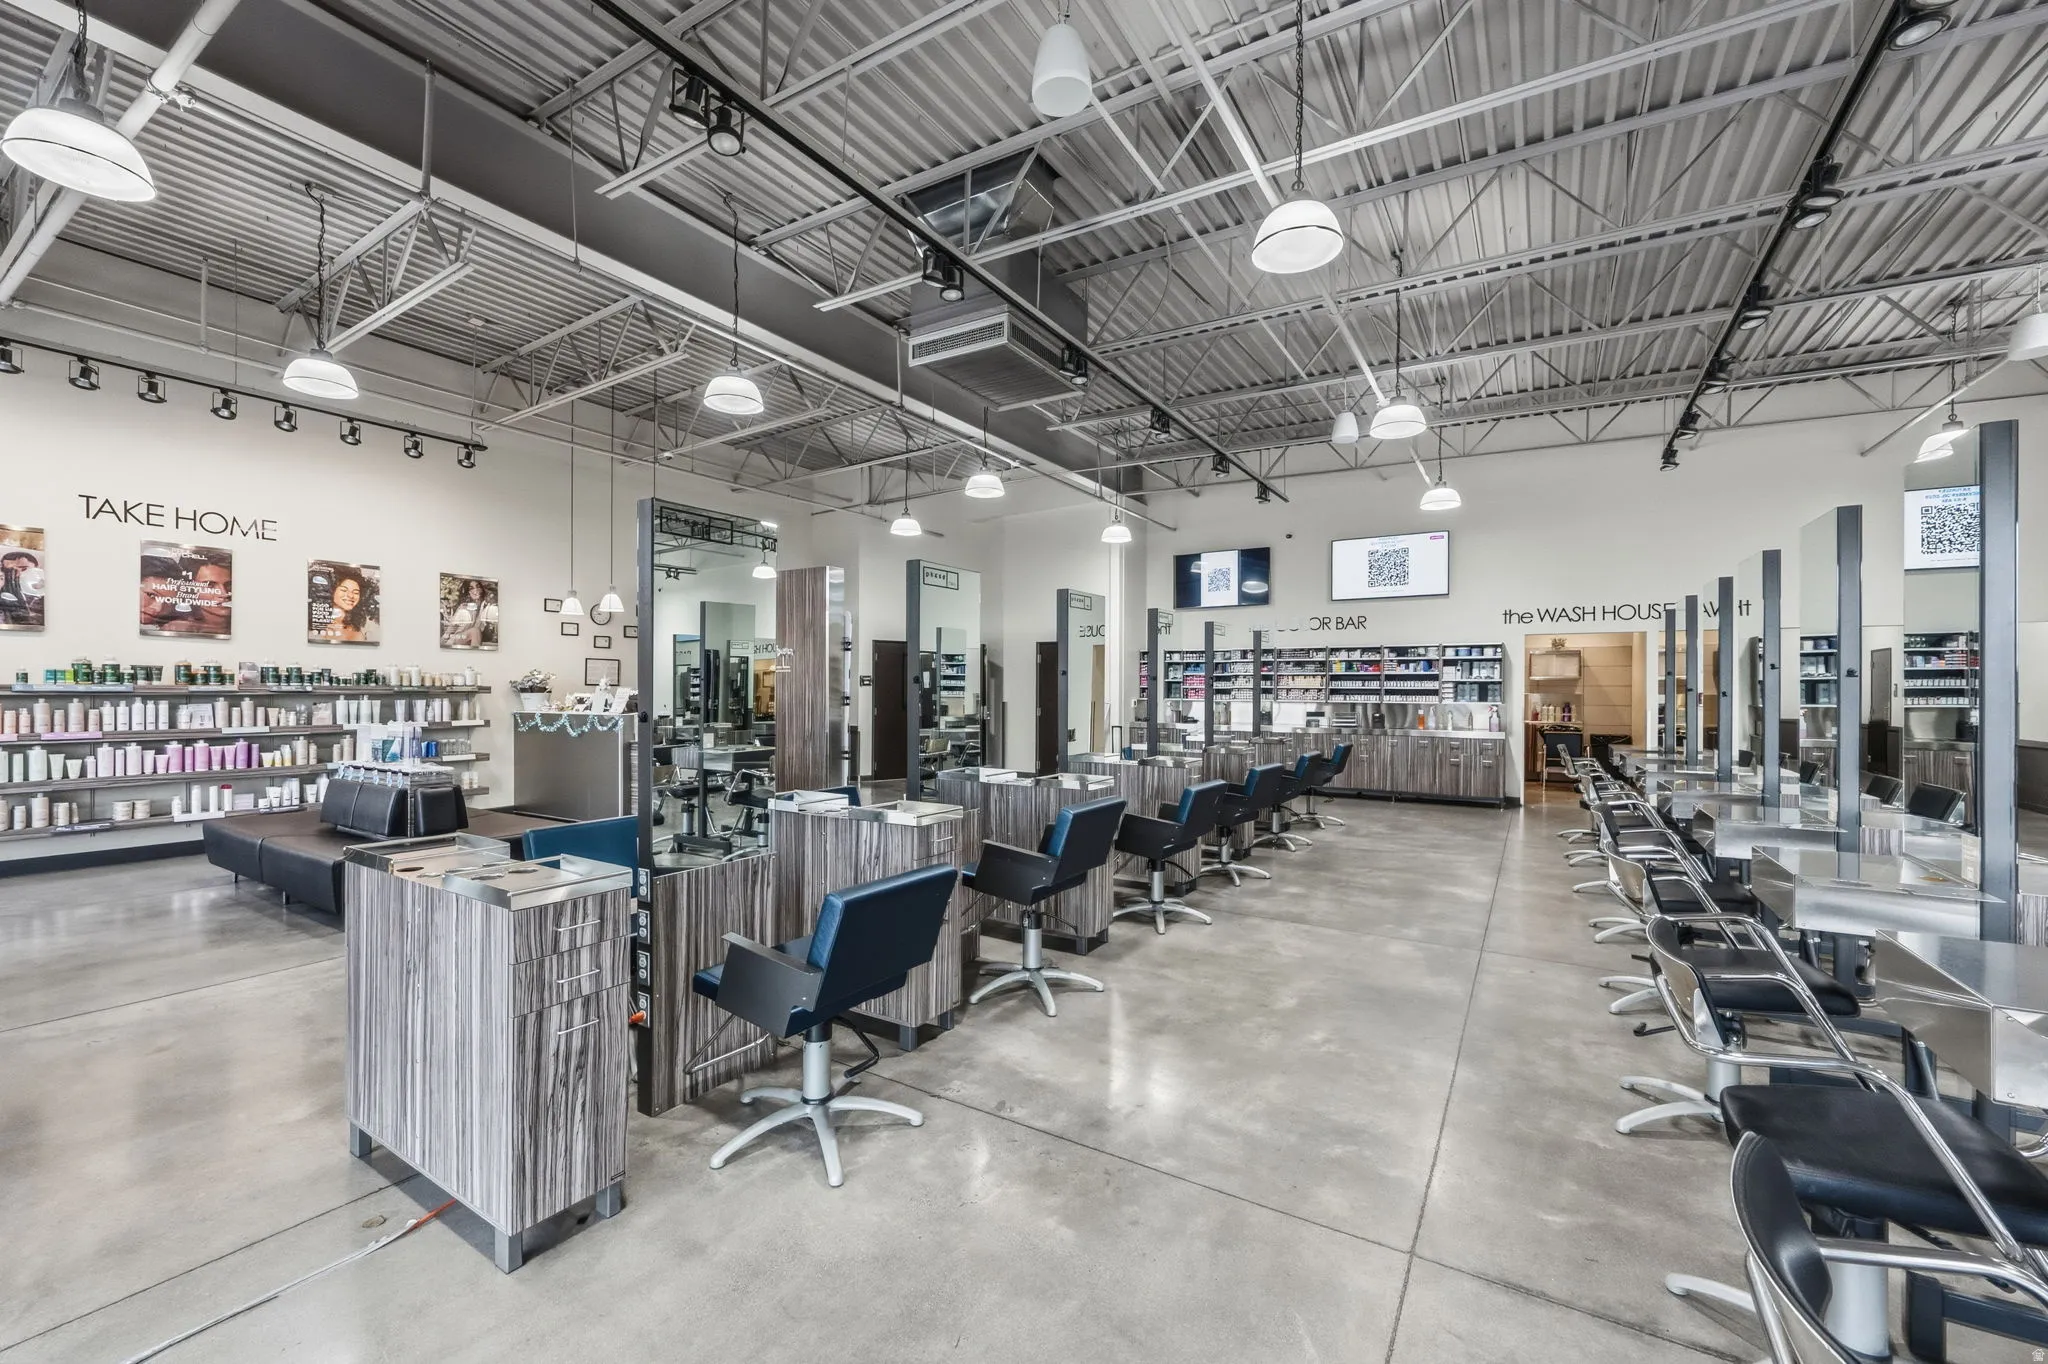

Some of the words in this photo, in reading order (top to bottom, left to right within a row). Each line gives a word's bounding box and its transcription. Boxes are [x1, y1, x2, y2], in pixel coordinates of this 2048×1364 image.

[78, 494, 165, 527] TAKE
[175, 507, 277, 541] HOME
[152, 582, 177, 591] HAIR
[179, 585, 222, 595] STYLING
[155, 596, 218, 607] WORLDWIDE
[1502, 609, 1534, 624] the
[1537, 606, 1596, 622] WASH
[1336, 616, 1367, 630] BAR
